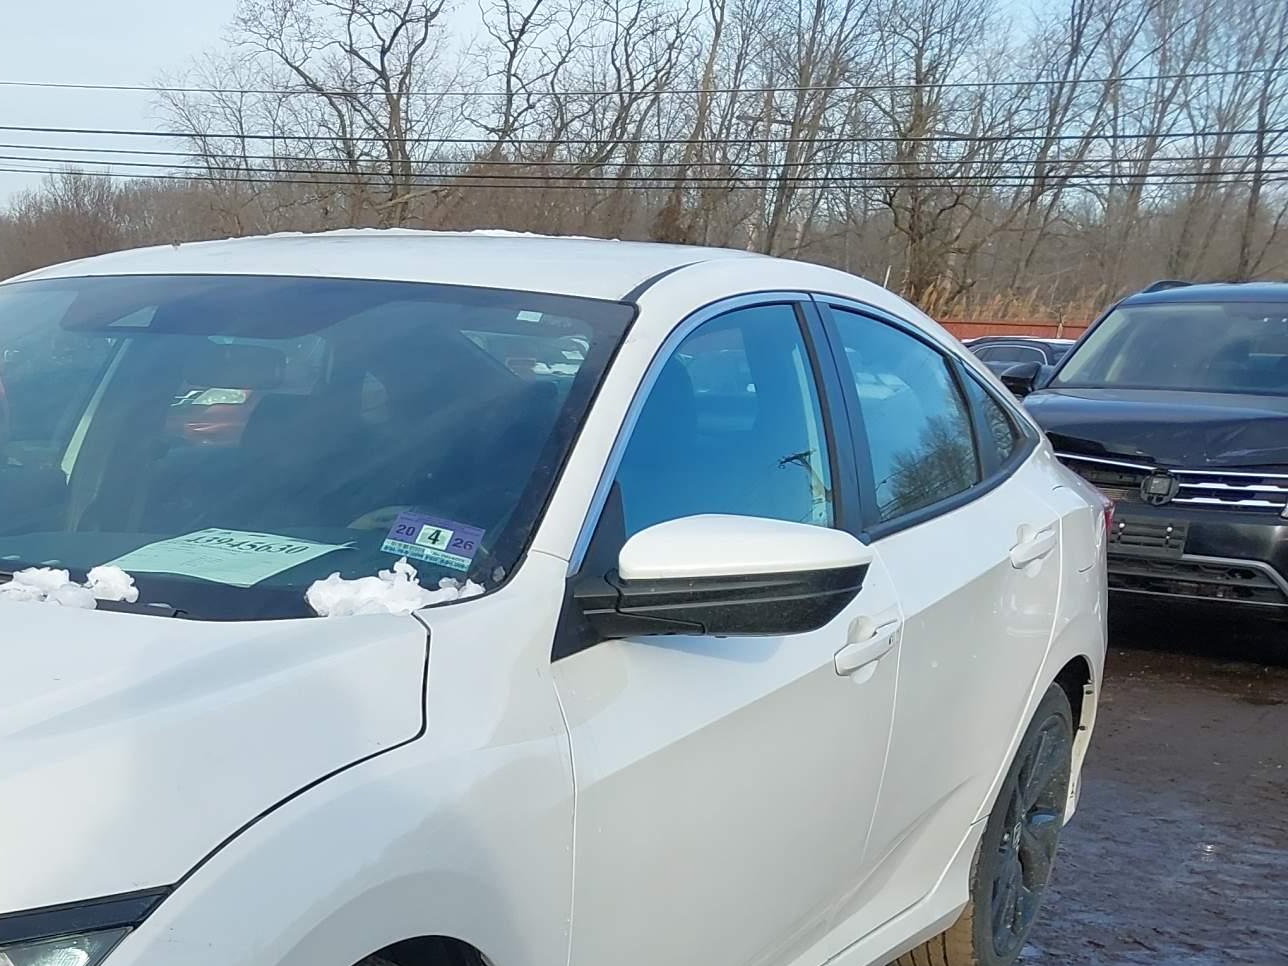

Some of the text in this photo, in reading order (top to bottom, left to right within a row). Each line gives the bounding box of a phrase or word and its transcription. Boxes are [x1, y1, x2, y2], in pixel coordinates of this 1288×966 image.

[396, 524, 474, 550] 20 4 26
